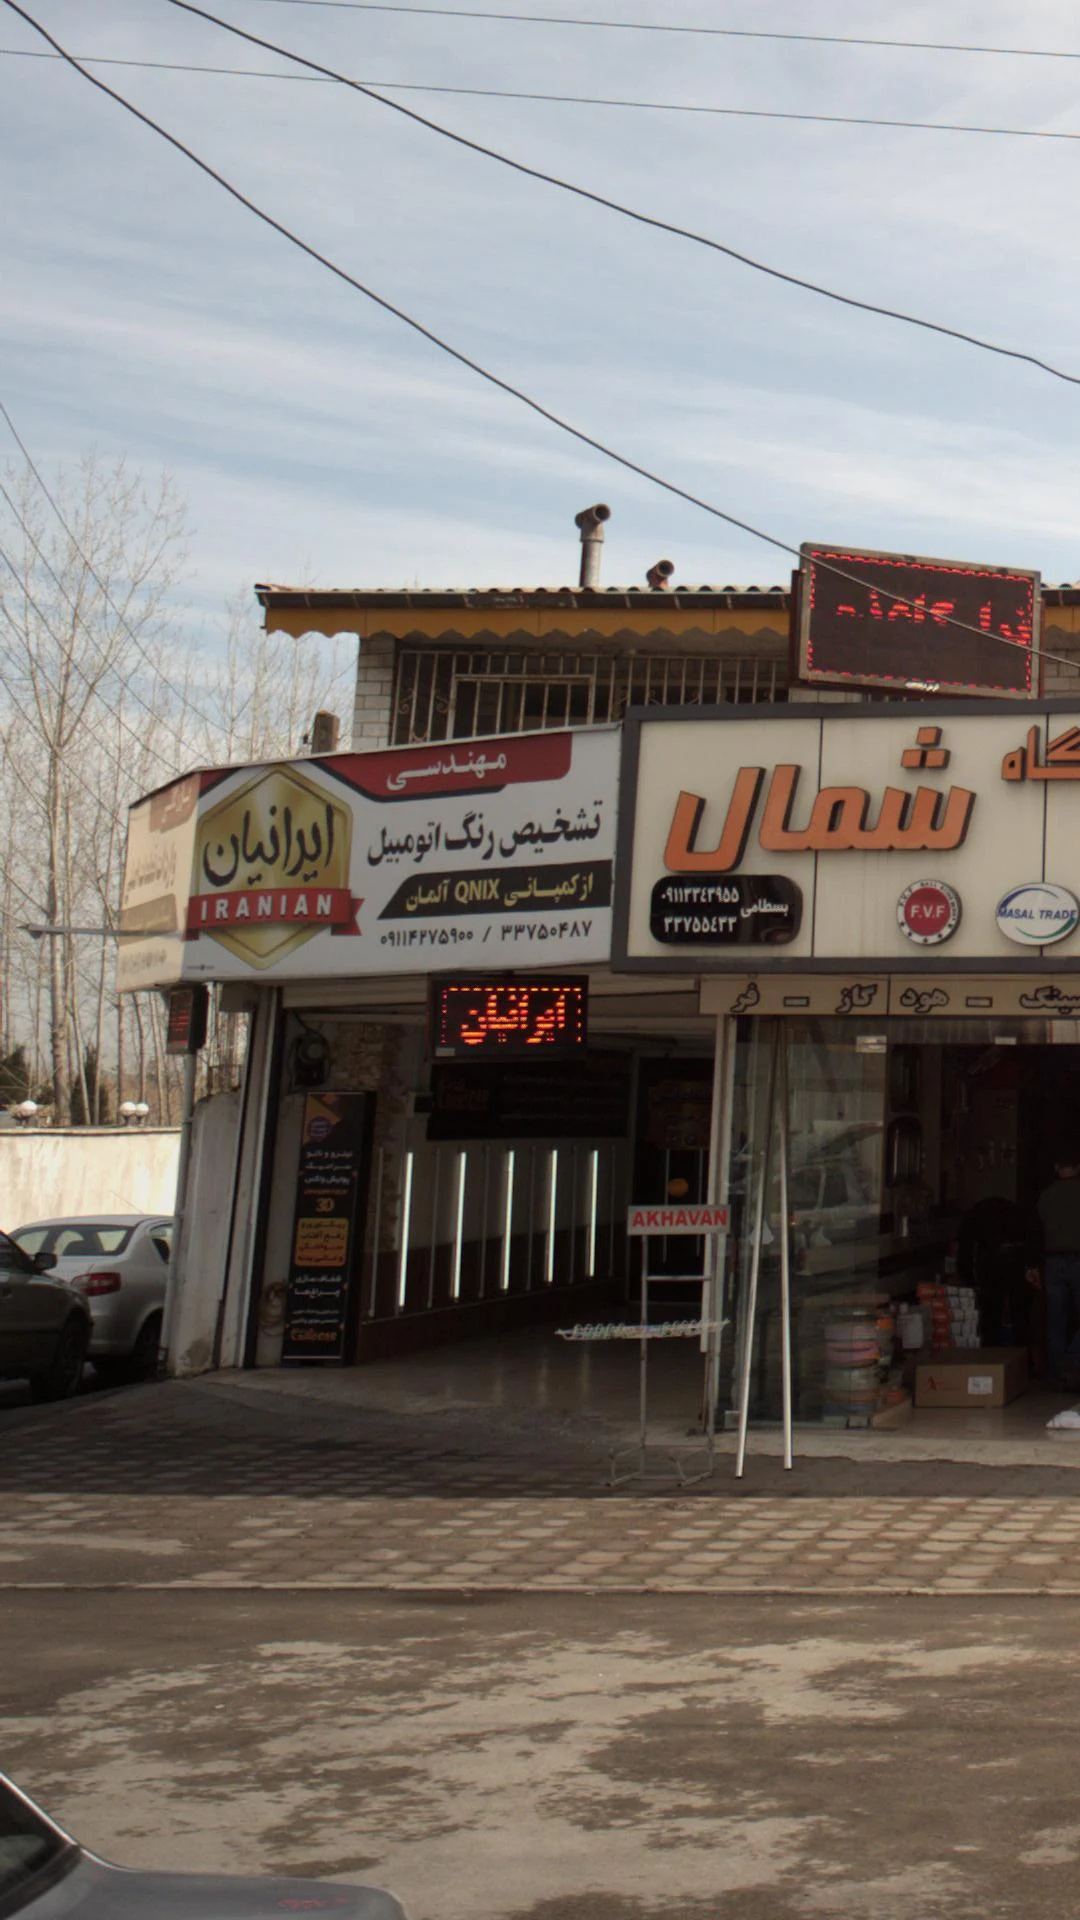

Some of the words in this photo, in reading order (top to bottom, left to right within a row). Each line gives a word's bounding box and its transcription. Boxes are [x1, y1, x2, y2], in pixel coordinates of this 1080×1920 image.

[1001, 724, 1080, 781] گاه
[386, 752, 507, 791] مهندسی
[663, 725, 976, 873] شمال
[203, 803, 334, 887] ایرانیان
[367, 821, 442, 866] اتومبیل
[445, 811, 495, 860] رنگ
[500, 800, 603, 858] تشخیص
[201, 893, 333, 921] IRANIAN
[405, 879, 450, 911] آلمان
[454, 878, 500, 904] QNIX
[740, 898, 789, 918] بسطامی
[997, 907, 1035, 920] MASAL
[900, 987, 949, 1013] هود
[632, 1210, 728, 1228] AKHAVAN
